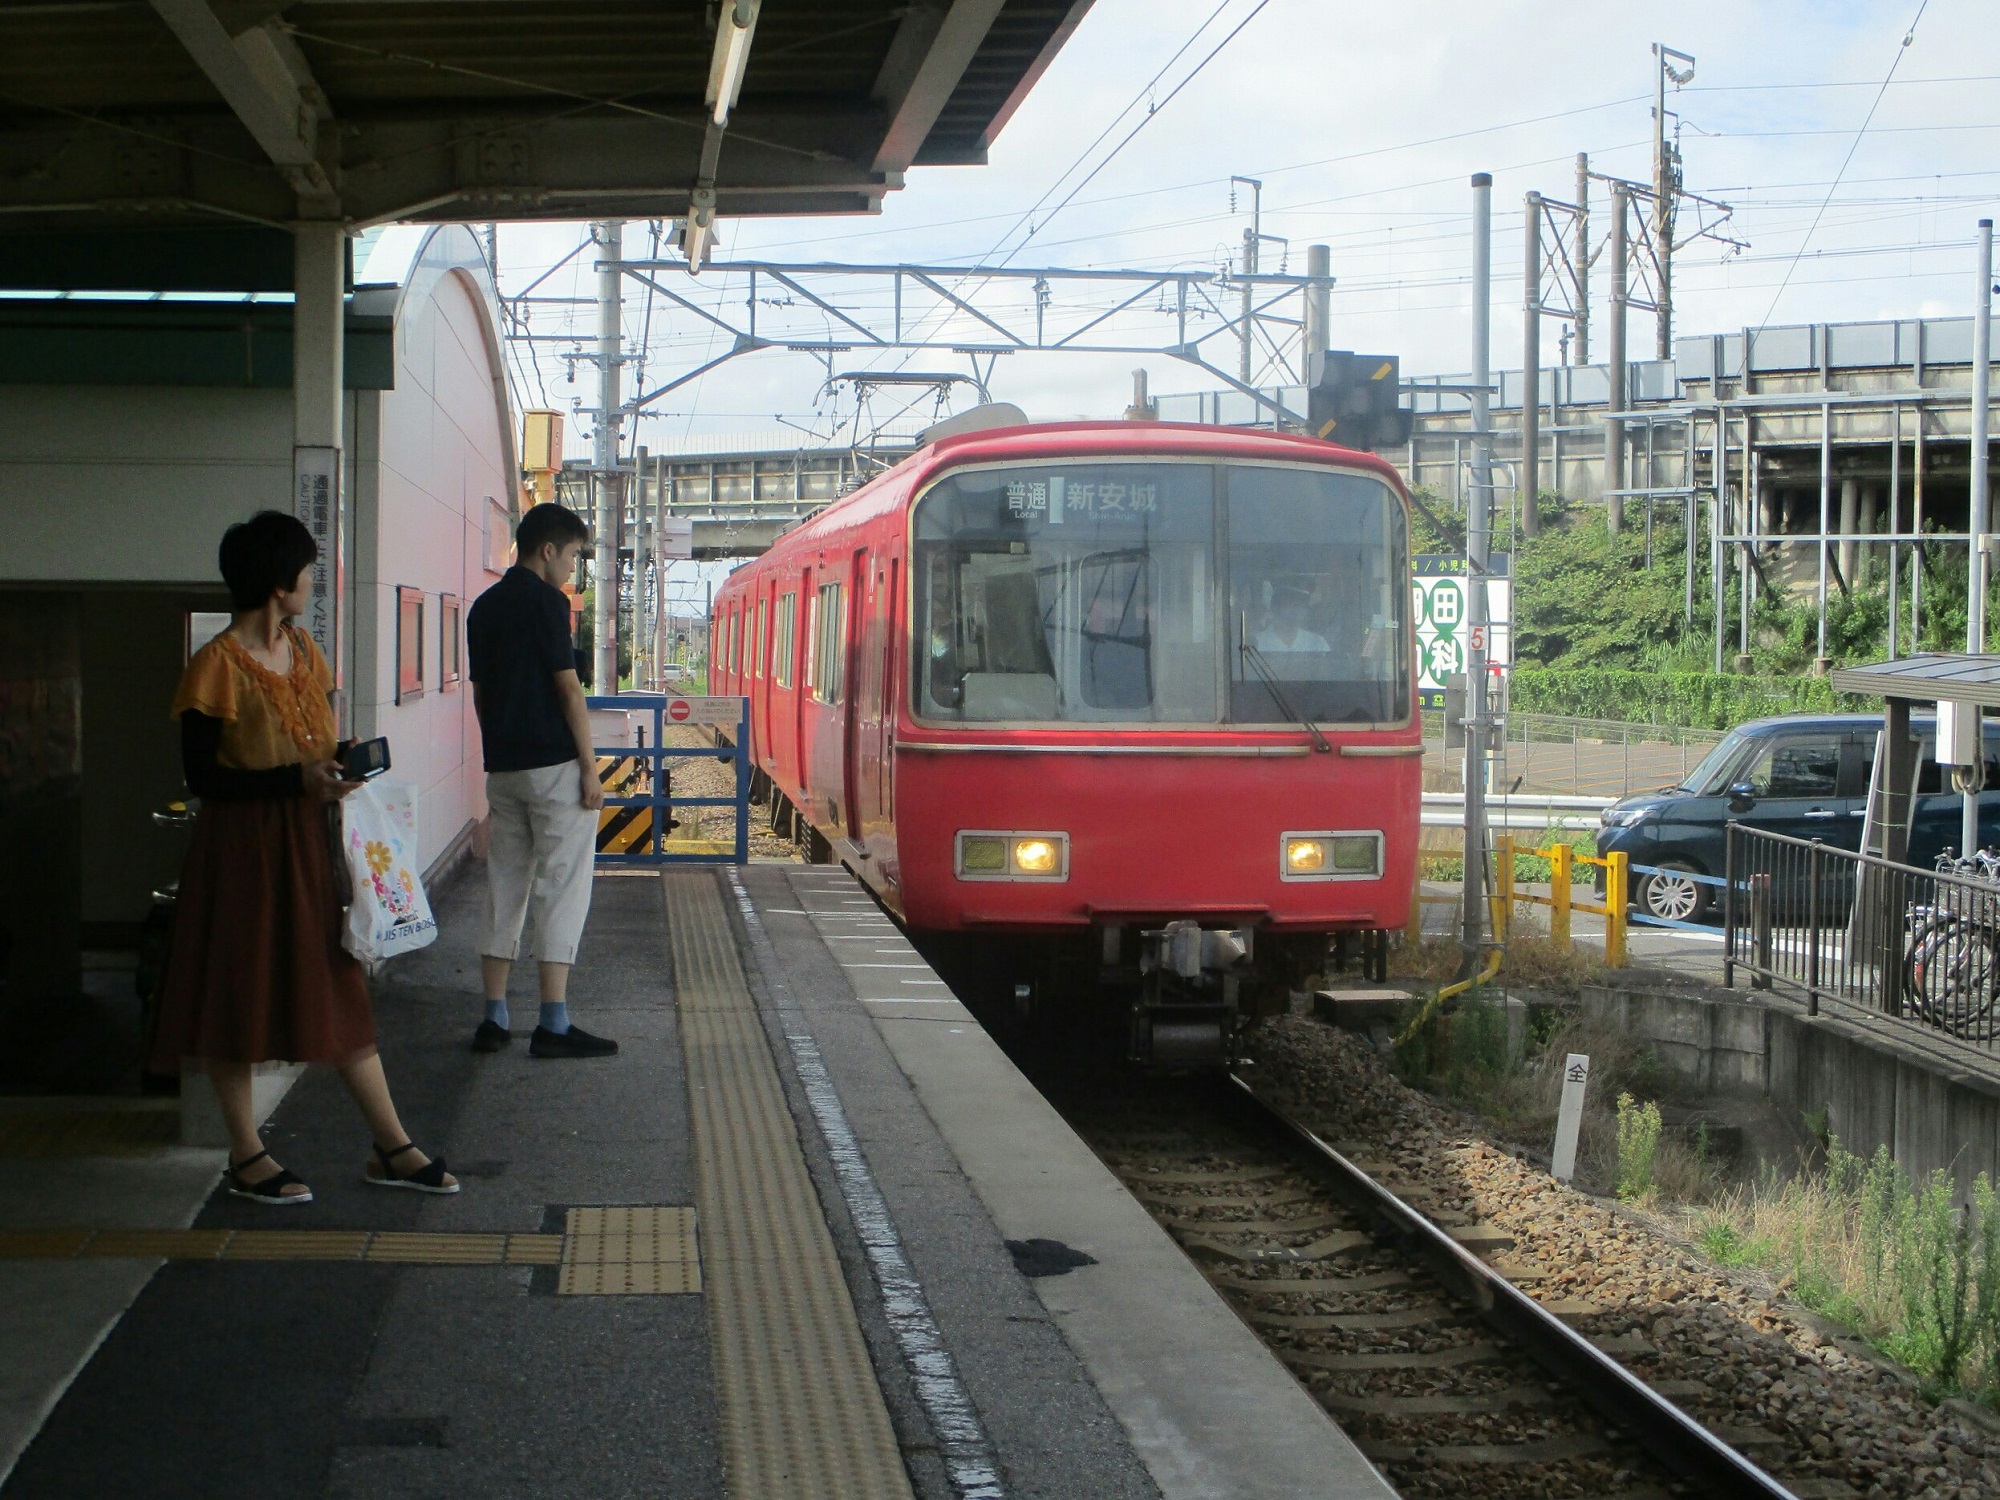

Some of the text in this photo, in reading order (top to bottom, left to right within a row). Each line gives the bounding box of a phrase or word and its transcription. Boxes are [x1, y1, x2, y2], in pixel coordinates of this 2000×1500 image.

[1007, 481, 1046, 510] 普通
[1067, 483, 1157, 512] 新安城
[1014, 511, 1038, 519] Local
[1471, 627, 1484, 649] 5
[398, 925, 413, 938] TEN
[1567, 1063, 1587, 1083] 全
